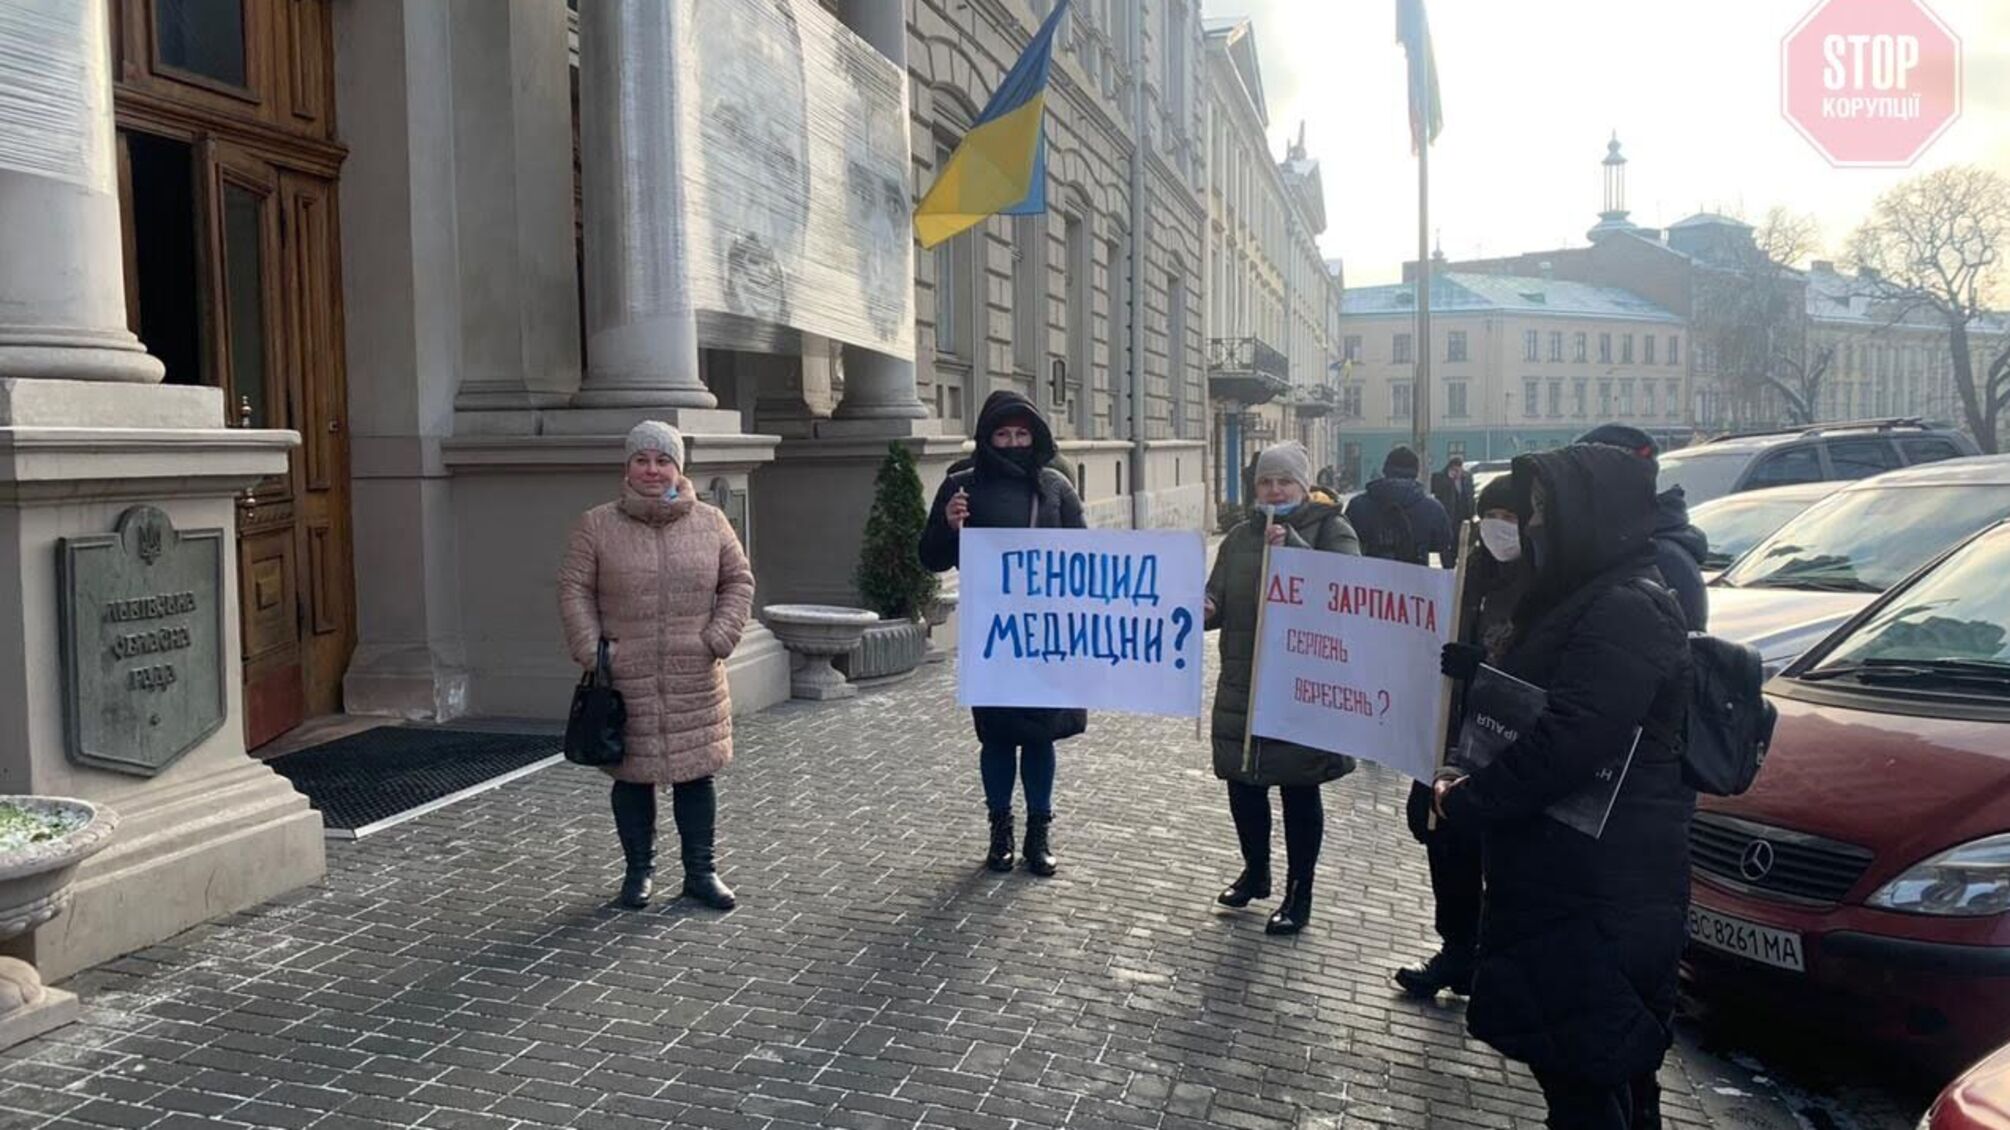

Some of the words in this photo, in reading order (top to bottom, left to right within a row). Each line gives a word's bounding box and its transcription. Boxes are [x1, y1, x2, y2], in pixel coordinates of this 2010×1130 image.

[1002, 550, 1159, 606] ГЕНОЦИД
[1267, 574, 1304, 605] ДЕ
[1328, 582, 1436, 632] ЗАРПЛАТА
[1286, 628, 1348, 663] СЕРПЕНЬ
[1713, 919, 1759, 955] 8261
